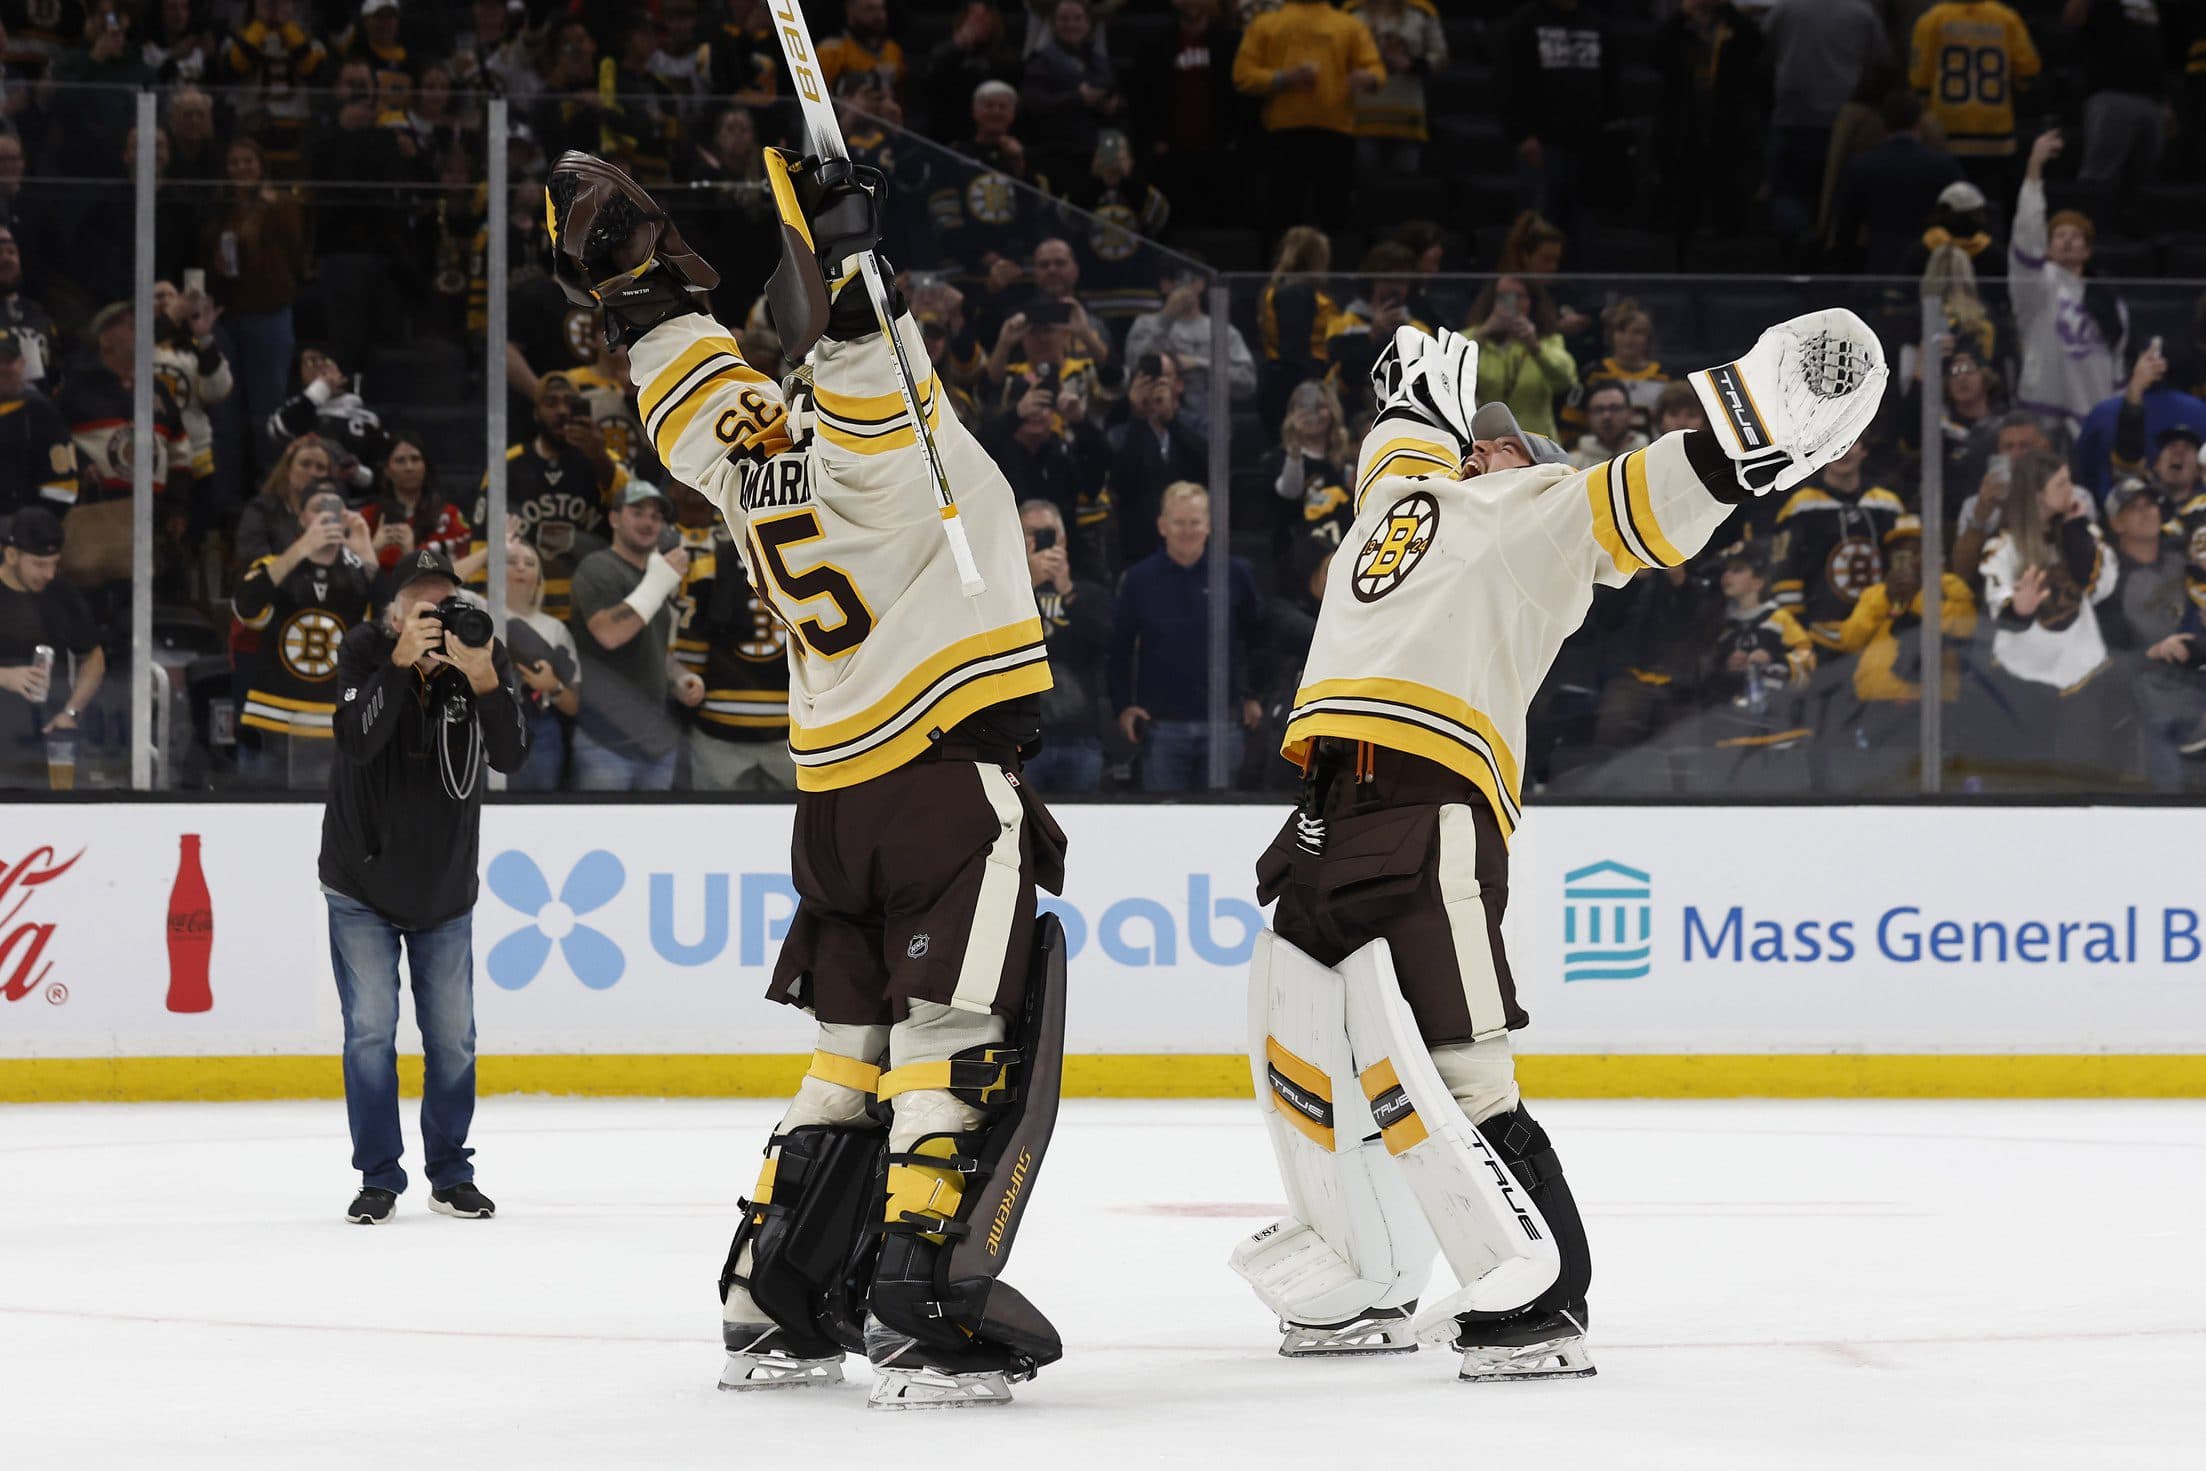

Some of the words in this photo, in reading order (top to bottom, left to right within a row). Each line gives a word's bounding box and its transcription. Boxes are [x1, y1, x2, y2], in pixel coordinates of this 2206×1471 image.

[1940, 45, 2005, 105] 88
[714, 389, 784, 444] 35
[1720, 370, 1760, 446] TRUE
[1366, 516, 1419, 576] B
[1411, 539, 1429, 553] 24
[304, 628, 328, 658] B
[1682, 906, 1856, 963] Mass
[1876, 905, 2136, 963] General
[2163, 906, 2202, 963] B
[1269, 1073, 1325, 1118] TRUE
[1373, 1095, 1411, 1119] TRUE
[1470, 1128, 1543, 1242] TRUE
